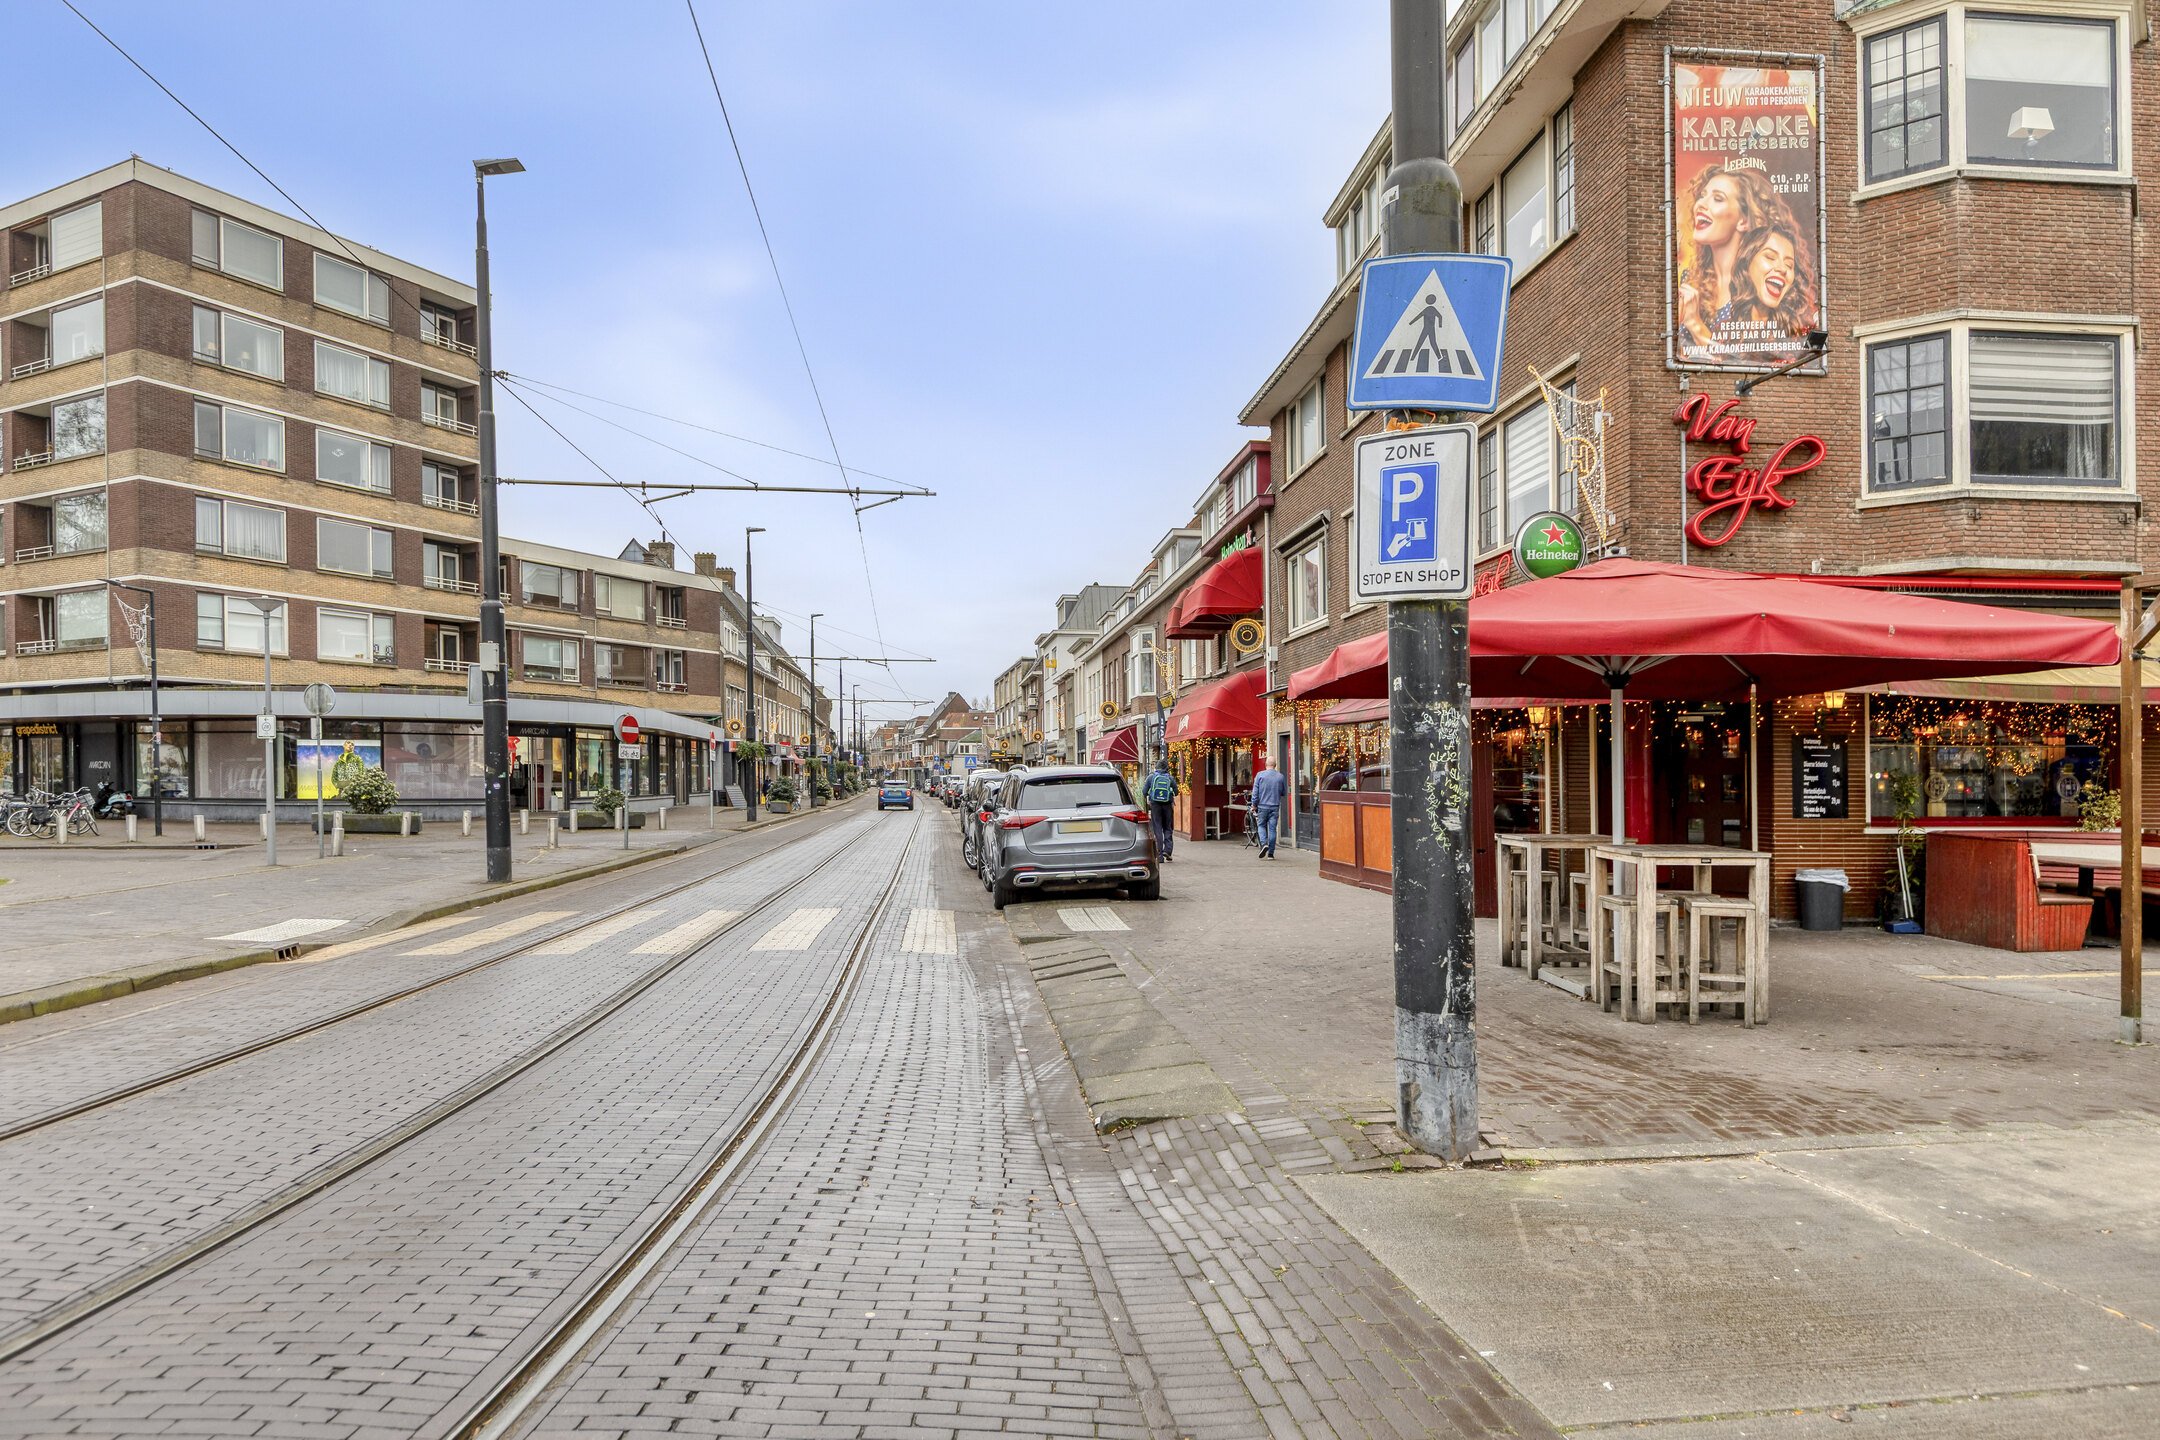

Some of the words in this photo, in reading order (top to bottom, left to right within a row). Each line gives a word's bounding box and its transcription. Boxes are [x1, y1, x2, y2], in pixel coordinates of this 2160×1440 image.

[1683, 87, 1742, 107] NIEUW
[1745, 86, 1808, 96] KARAOKEKAMERS
[1745, 96, 1758, 106] TOT
[1760, 96, 1769, 106] 10
[1770, 96, 1808, 106] PERSONEN
[1682, 115, 1810, 137] KARAOKE
[1682, 136, 1809, 151] HILLEGERSBERG
[1724, 157, 1767, 173] LEBBINK
[1795, 173, 1812, 183] P.P.
[1773, 184, 1789, 194] PER
[1792, 183, 1809, 193] UUR
[1720, 321, 1765, 331] RESERVEER
[1767, 320, 1777, 329] NU
[1711, 331, 1728, 340] AAN
[1730, 331, 1740, 340] DE
[1743, 330, 1759, 339] BAR
[1761, 330, 1771, 339] OF
[1773, 329, 1786, 338] VIA
[1673, 392, 1757, 453] Van
[1385, 442, 1435, 462] ZONE
[1392, 472, 1424, 522] P
[1526, 549, 1578, 561] Heineken
[1363, 572, 1391, 586] STOP
[1395, 570, 1413, 583] EN
[1418, 569, 1461, 582] SHOP
[15, 723, 58, 737] grapedistrict
